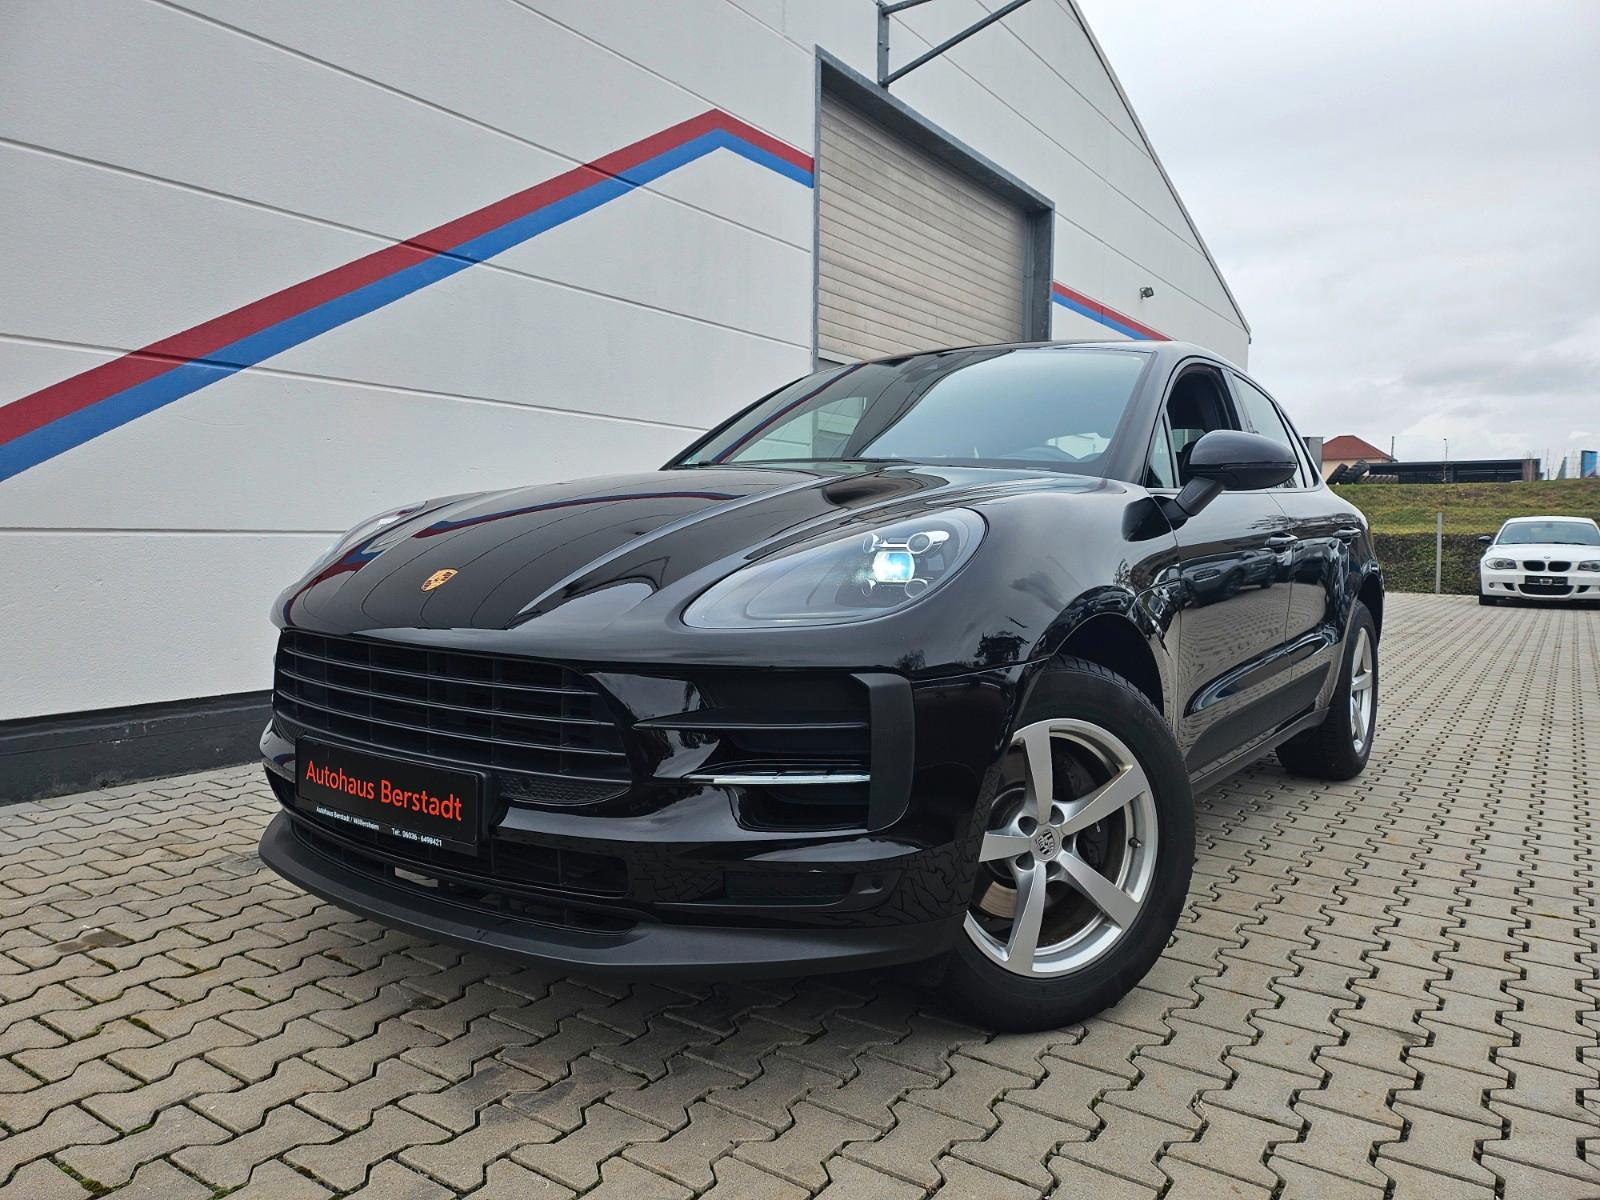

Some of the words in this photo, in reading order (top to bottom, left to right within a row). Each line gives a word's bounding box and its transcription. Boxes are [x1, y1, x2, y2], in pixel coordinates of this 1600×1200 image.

[305, 760, 375, 800] Autohaus
[380, 779, 462, 822] Berstadt
[316, 806, 333, 817] Autohaus
[334, 811, 350, 822] Berstadt
